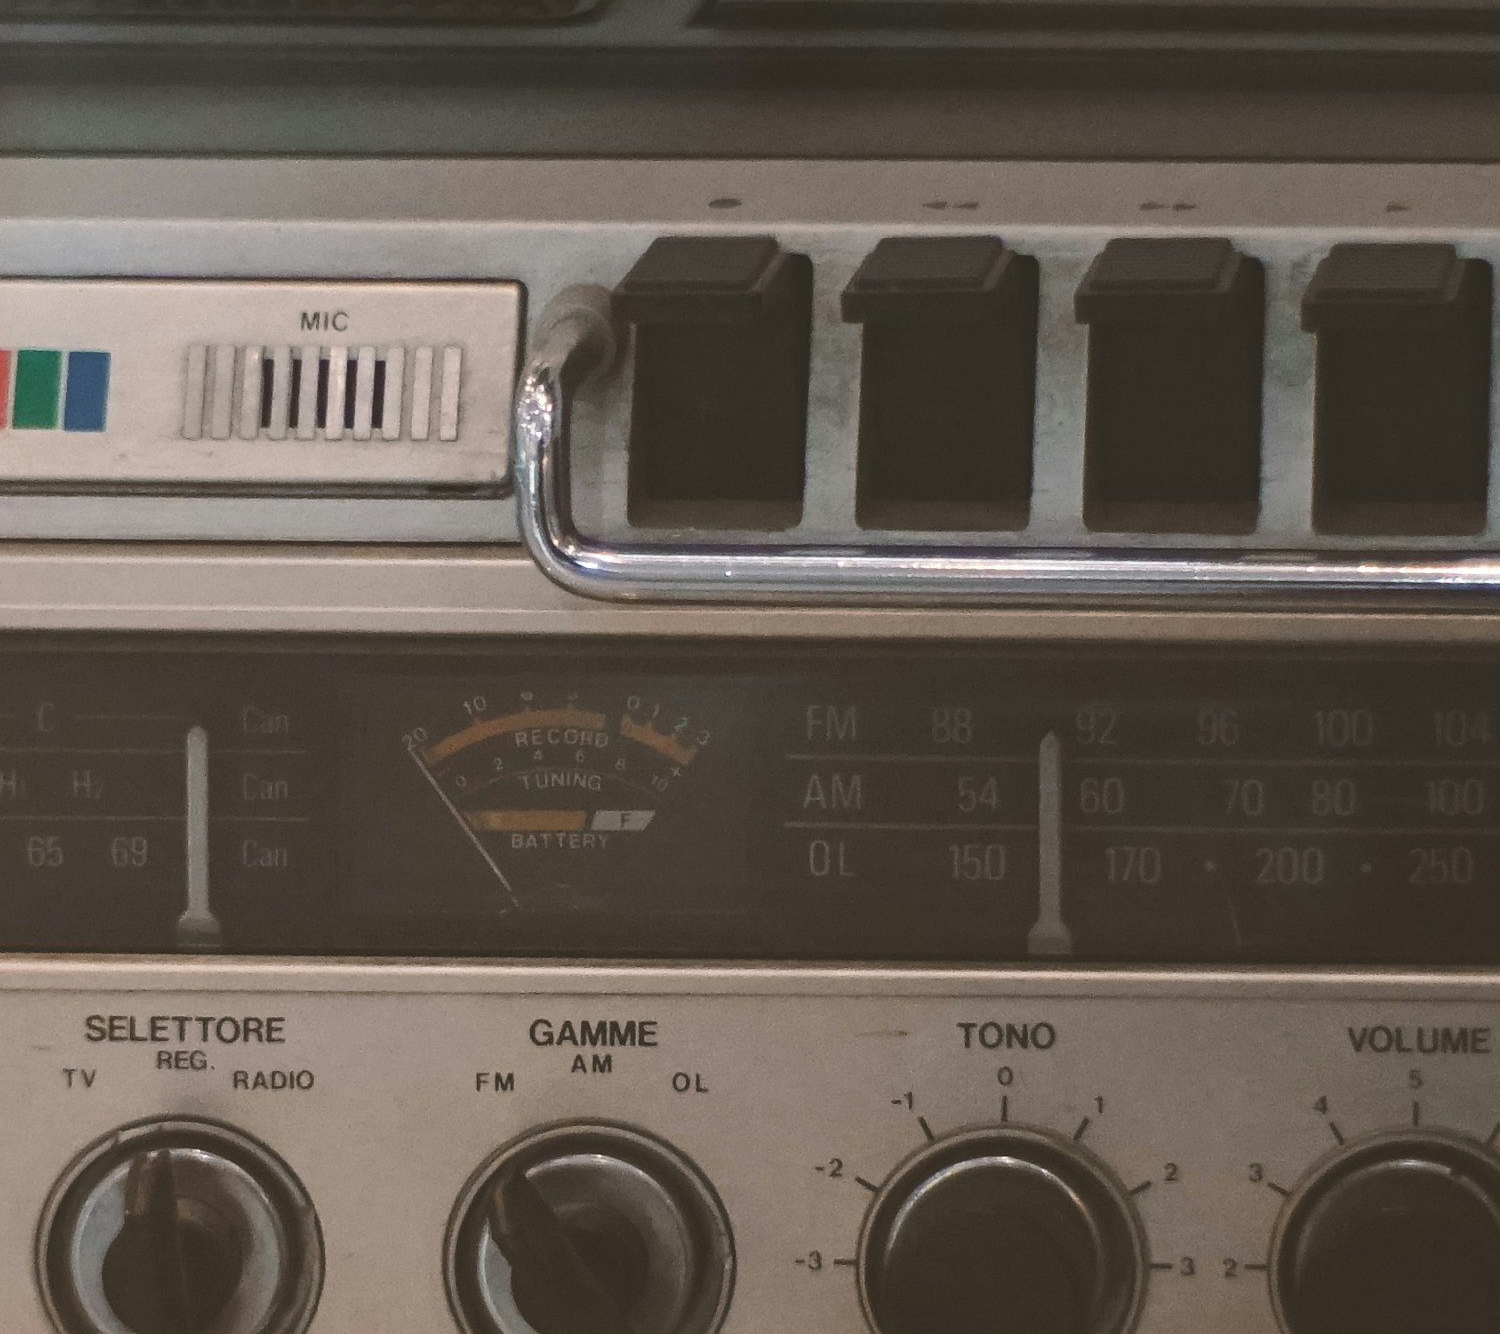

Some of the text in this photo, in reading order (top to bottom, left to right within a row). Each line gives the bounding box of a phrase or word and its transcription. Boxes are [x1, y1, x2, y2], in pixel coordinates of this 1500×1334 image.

[301, 310, 349, 332] MIC
[463, 695, 487, 715] 10
[36, 701, 54, 733] C
[241, 704, 290, 735] Can
[806, 705, 857, 741] FM
[931, 706, 973, 744] 88
[1075, 708, 1117, 746] 92
[1198, 708, 1239, 747] 96
[1315, 709, 1375, 747] 100
[1434, 709, 1494, 747] 104
[514, 729, 609, 748] RECORD
[241, 768, 289, 799] Can
[520, 772, 602, 791] TUNING
[803, 773, 862, 810] AM
[957, 776, 998, 812] 54
[1080, 777, 1125, 814] 60
[1223, 778, 1266, 816] 70
[1312, 778, 1356, 816] 80
[1427, 778, 1485, 816] 100
[619, 814, 631, 828] F
[26, 835, 64, 867] 65
[110, 836, 148, 868] 69
[241, 837, 288, 868] Can
[511, 833, 610, 850] BATTERY
[949, 843, 1006, 881] 150
[1105, 846, 1161, 884] 170
[1256, 846, 1324, 885] 200
[1409, 846, 1474, 885] 250
[84, 1014, 286, 1045] SELETTORE
[529, 1020, 658, 1047] GAMME
[957, 1022, 1056, 1051] TONO
[1347, 1027, 1491, 1056] VOLUME
[156, 1049, 214, 1071] REG.
[571, 1054, 613, 1074] AM
[63, 1068, 97, 1088] TV
[233, 1069, 315, 1091] RADIO
[475, 1072, 514, 1093] FM
[672, 1073, 708, 1093] OL
[996, 1067, 1013, 1086] 0
[1409, 1070, 1422, 1090] 5
[1314, 1096, 1328, 1115] 4
[1164, 1163, 1179, 1182] 2
[1248, 1164, 1263, 1184] 3
[1181, 1258, 1195, 1276] 3
[1223, 1258, 1237, 1277] 2
